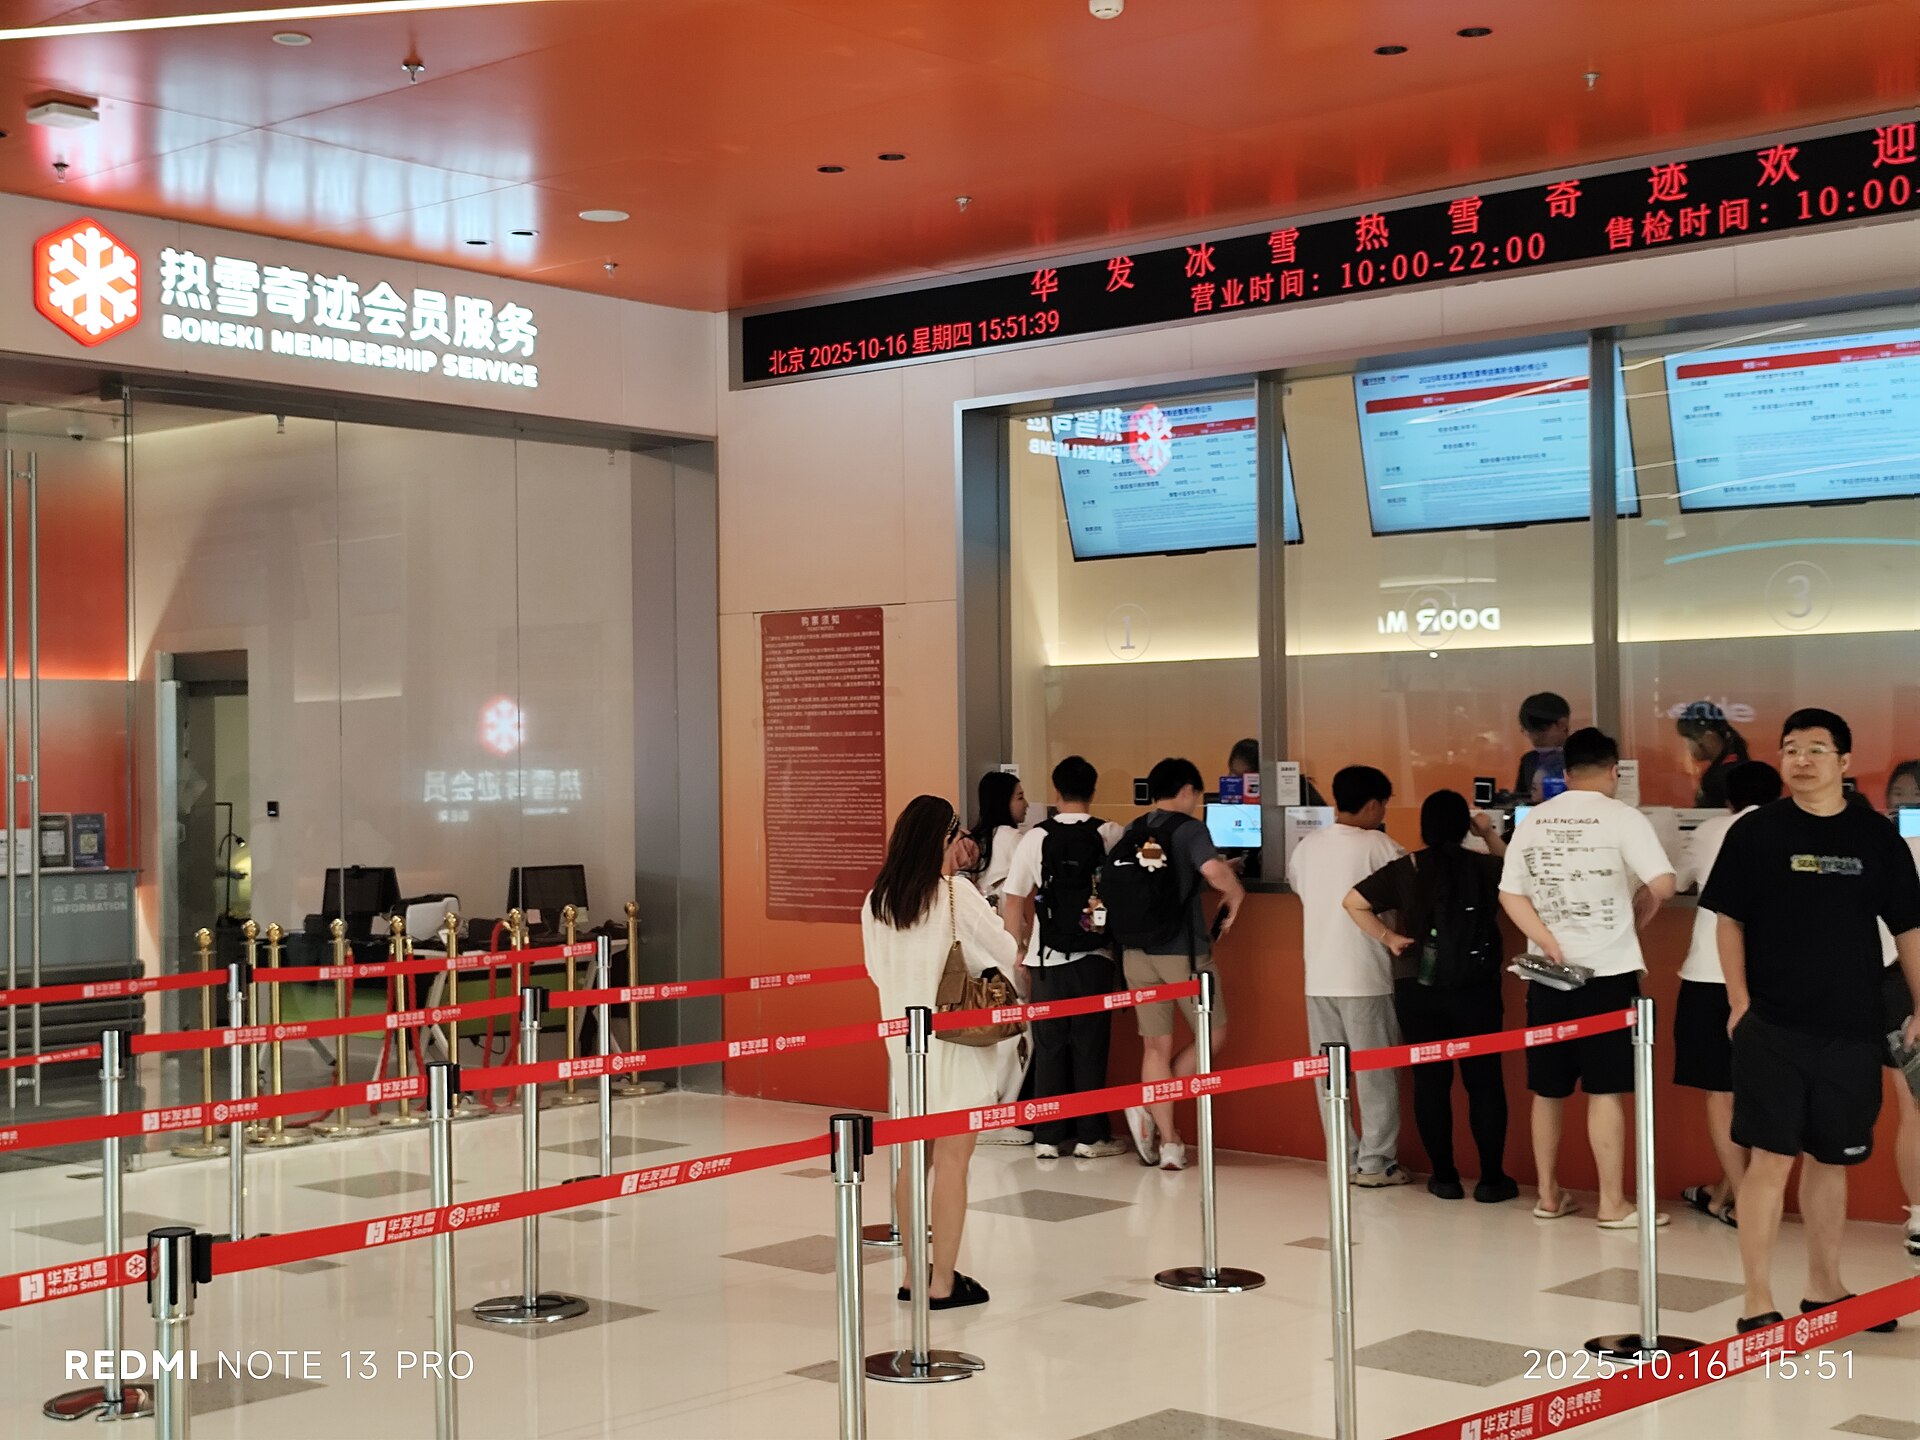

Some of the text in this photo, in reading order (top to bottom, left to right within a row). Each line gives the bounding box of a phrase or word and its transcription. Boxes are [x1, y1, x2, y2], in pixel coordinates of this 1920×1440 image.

[1340, 233, 1546, 288] 10:00-22:00
[160, 246, 538, 357] 热雪奇迹会员服务
[161, 313, 539, 389] BONSKI MEMBERSHIP SERVICE
[769, 310, 1060, 374] 北京 2025-10-16 星期四 15:51:39
[1120, 615, 1136, 650] 1
[386, 1225, 434, 1241] Huafa Snow
[388, 1211, 436, 1232] 华发冰雪
[47, 1260, 107, 1286] 华发冰雪
[48, 1278, 107, 1296] Huafa Snow
[1745, 1325, 1784, 1353] 华发冰雪
[1483, 1388, 1601, 1434] 华发冰雪 热雪奇迹
[1510, 1426, 1534, 1439] Snow
